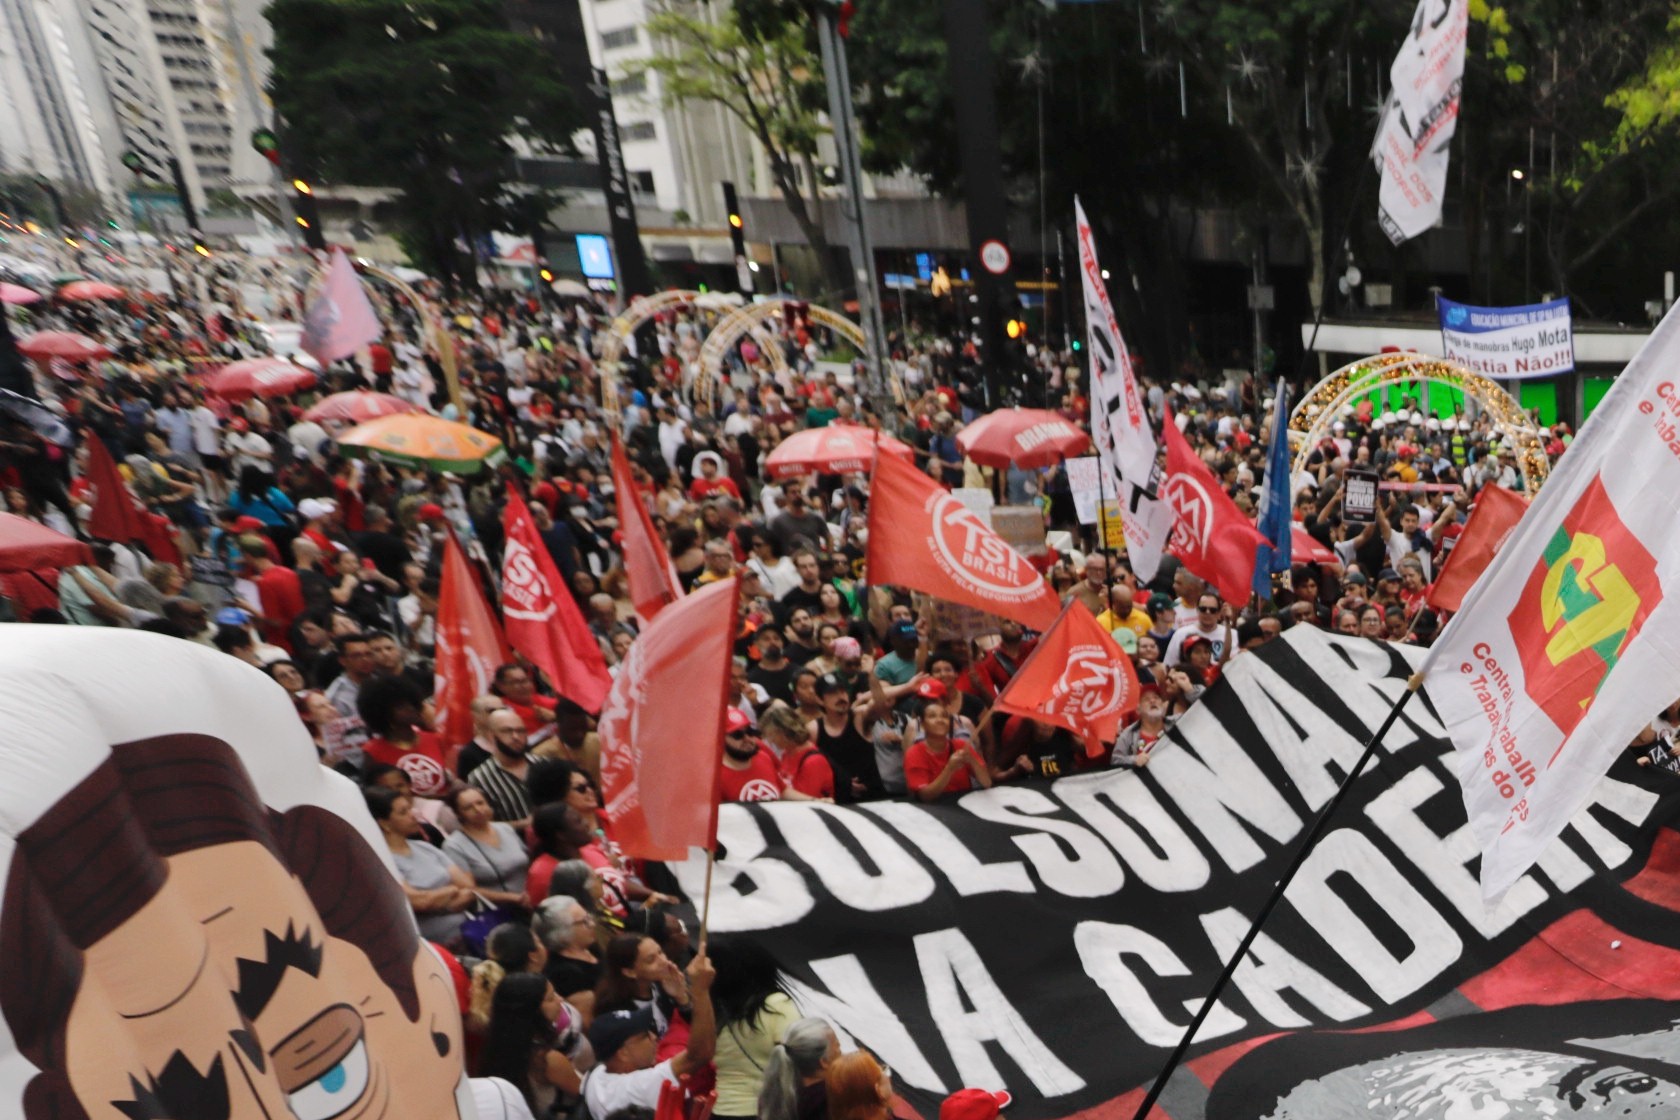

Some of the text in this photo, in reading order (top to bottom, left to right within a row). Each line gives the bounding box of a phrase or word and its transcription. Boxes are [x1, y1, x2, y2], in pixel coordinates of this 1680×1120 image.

[1511, 336, 1535, 354] Hugo
[1538, 328, 1568, 348] Mota
[1515, 350, 1572, 373] Não!!!
[1638, 399, 1655, 415] e
[962, 551, 1022, 587] BRASIL
[1460, 661, 1473, 675] e
[1491, 770, 1515, 799] do
[670, 621, 1462, 934] BOLSONAR
[1072, 764, 1660, 1048] CADEA
